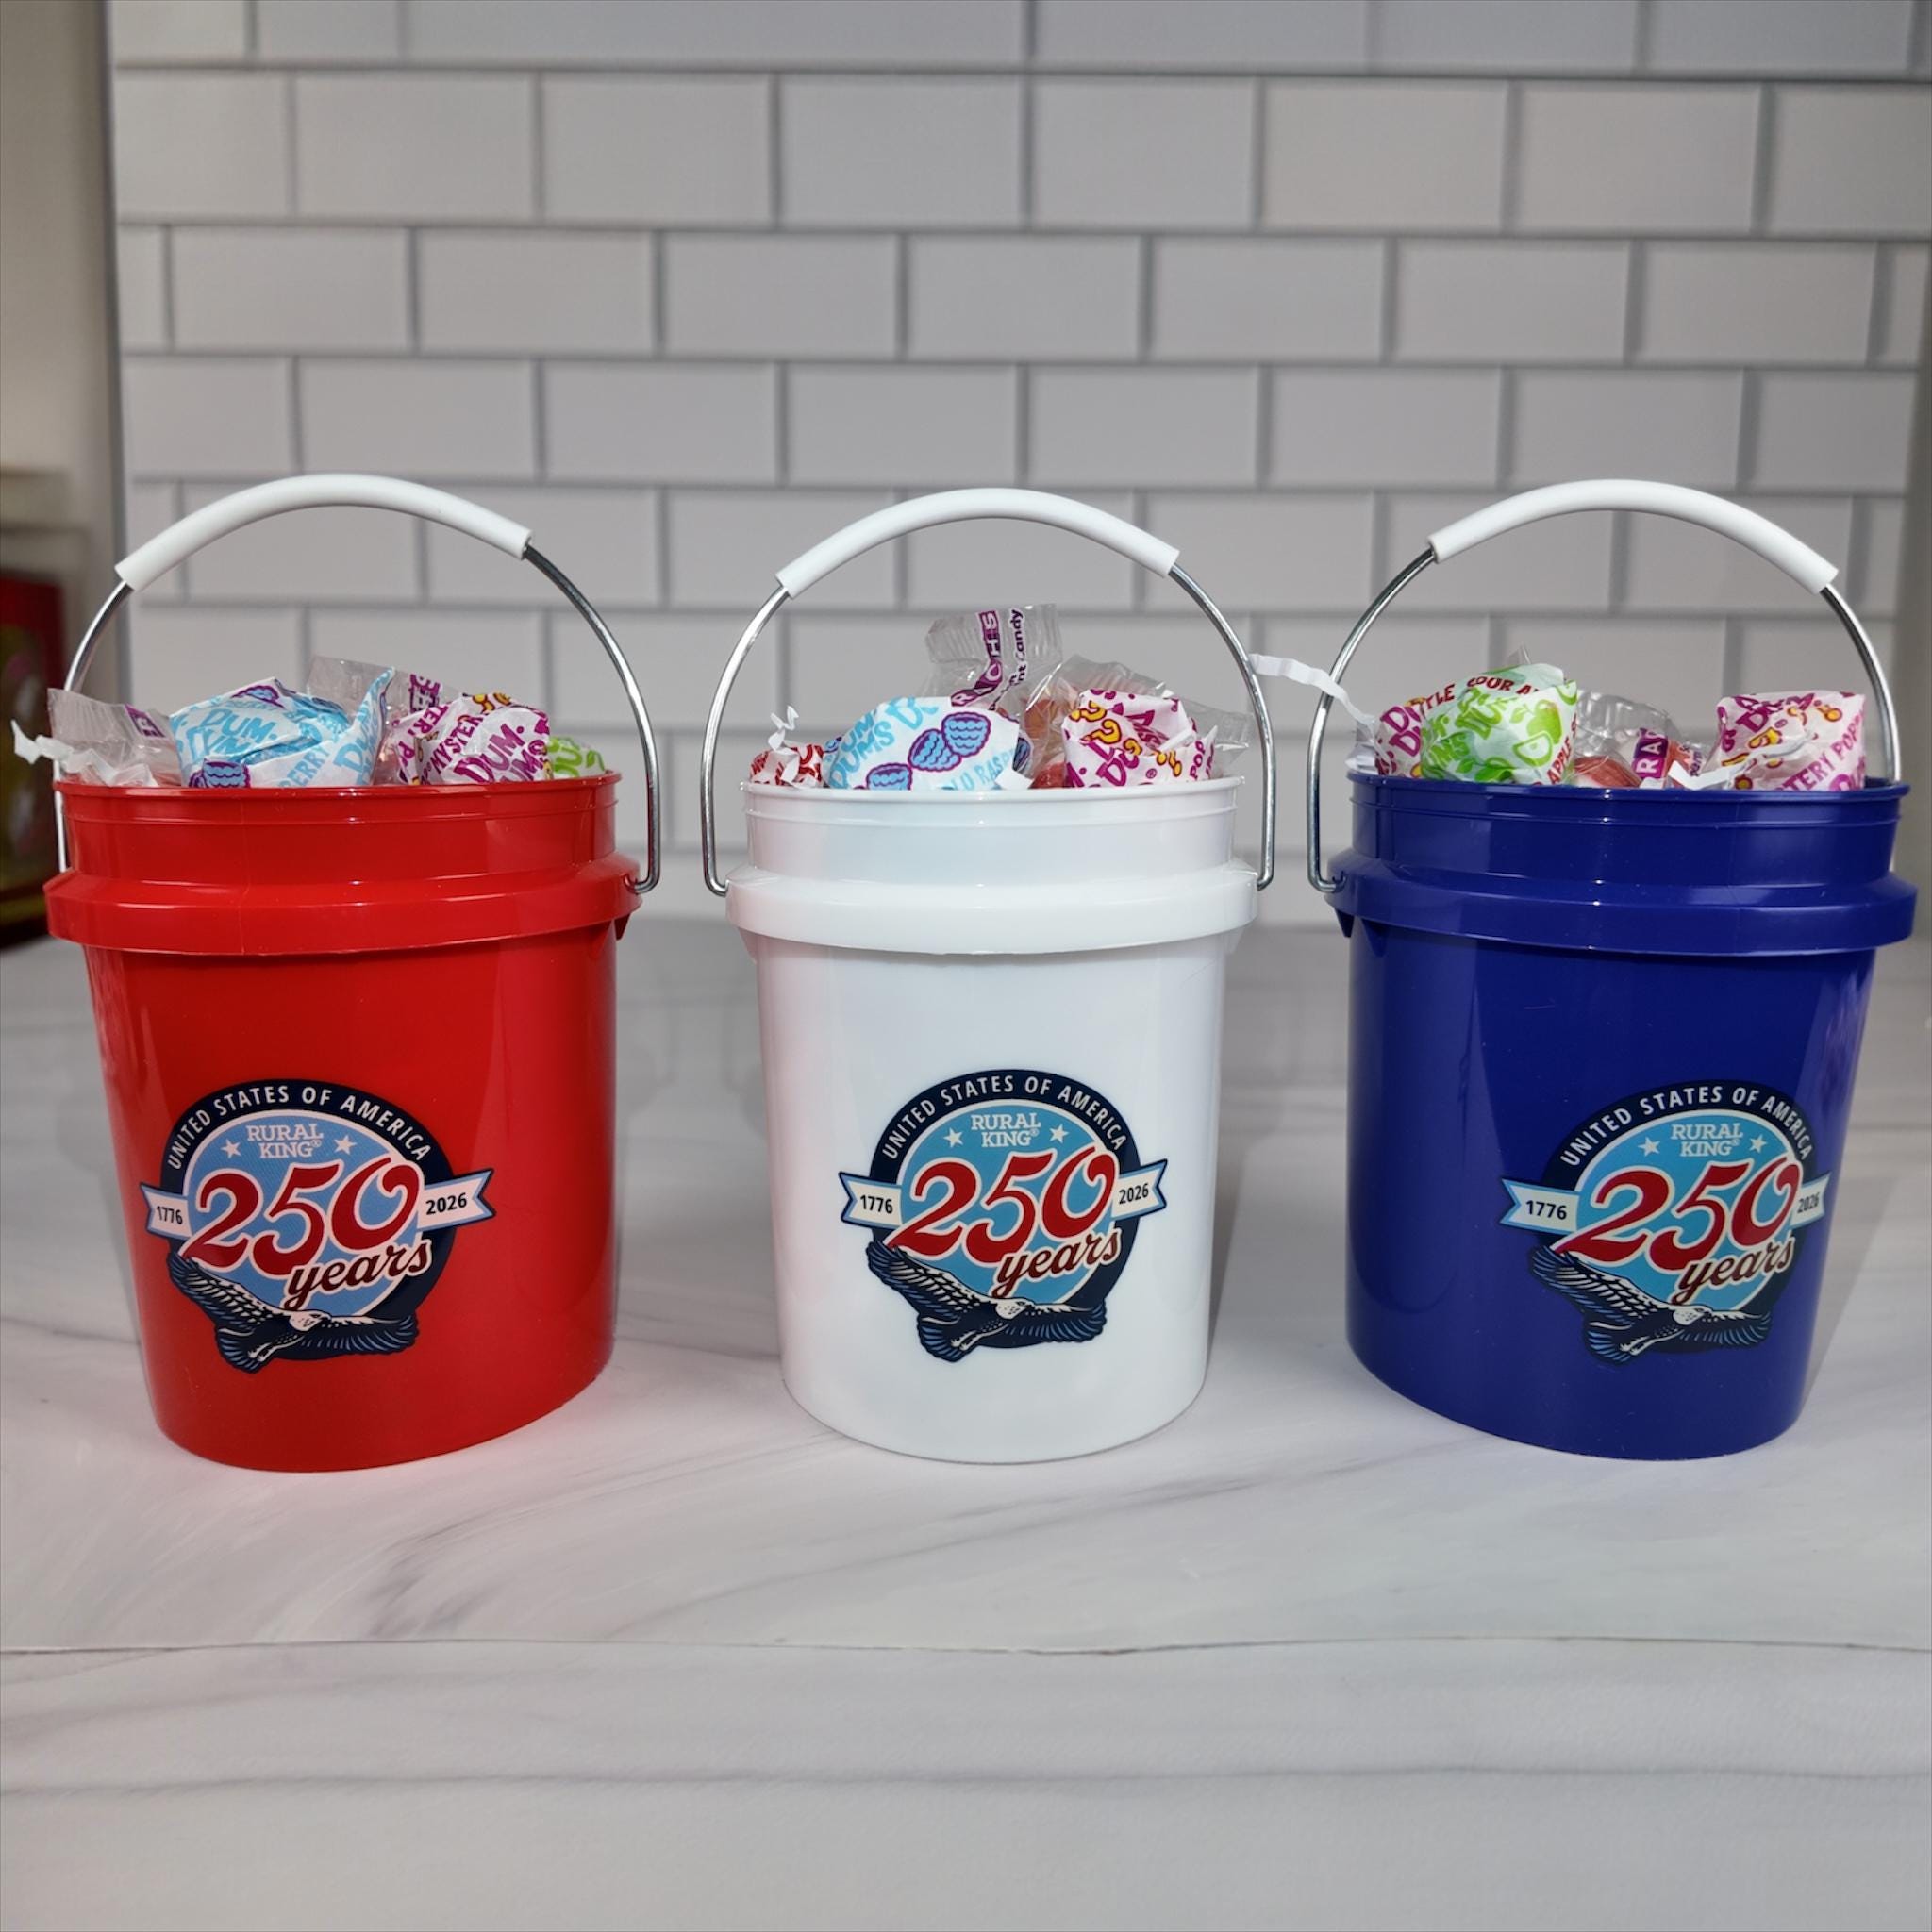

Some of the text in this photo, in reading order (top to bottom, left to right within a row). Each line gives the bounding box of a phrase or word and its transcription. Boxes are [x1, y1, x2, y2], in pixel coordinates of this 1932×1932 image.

[167, 1086, 432, 1170] UNITED STATES OF AMERICA
[246, 1123, 324, 1142] RURAL
[882, 1075, 1127, 1159] UNITED STATES OF AMERICA
[970, 1112, 1042, 1130] RURAL
[1559, 1086, 1814, 1167] UNITED STATES OF AMERICA
[1670, 1123, 1744, 1141] RURAL
[156, 1205, 184, 1225] 1776
[180, 1157, 422, 1276] 250
[425, 1192, 468, 1216] 2026
[859, 1194, 893, 1215] 1776
[885, 1145, 1117, 1264] 250
[1118, 1183, 1150, 1205] 2026
[1524, 1199, 1568, 1220] 1776
[1553, 1157, 1801, 1271] 250
[1796, 1192, 1820, 1214] 2026
[282, 1238, 433, 1312] years
[991, 1228, 1122, 1299] years
[1669, 1231, 1796, 1306] years
